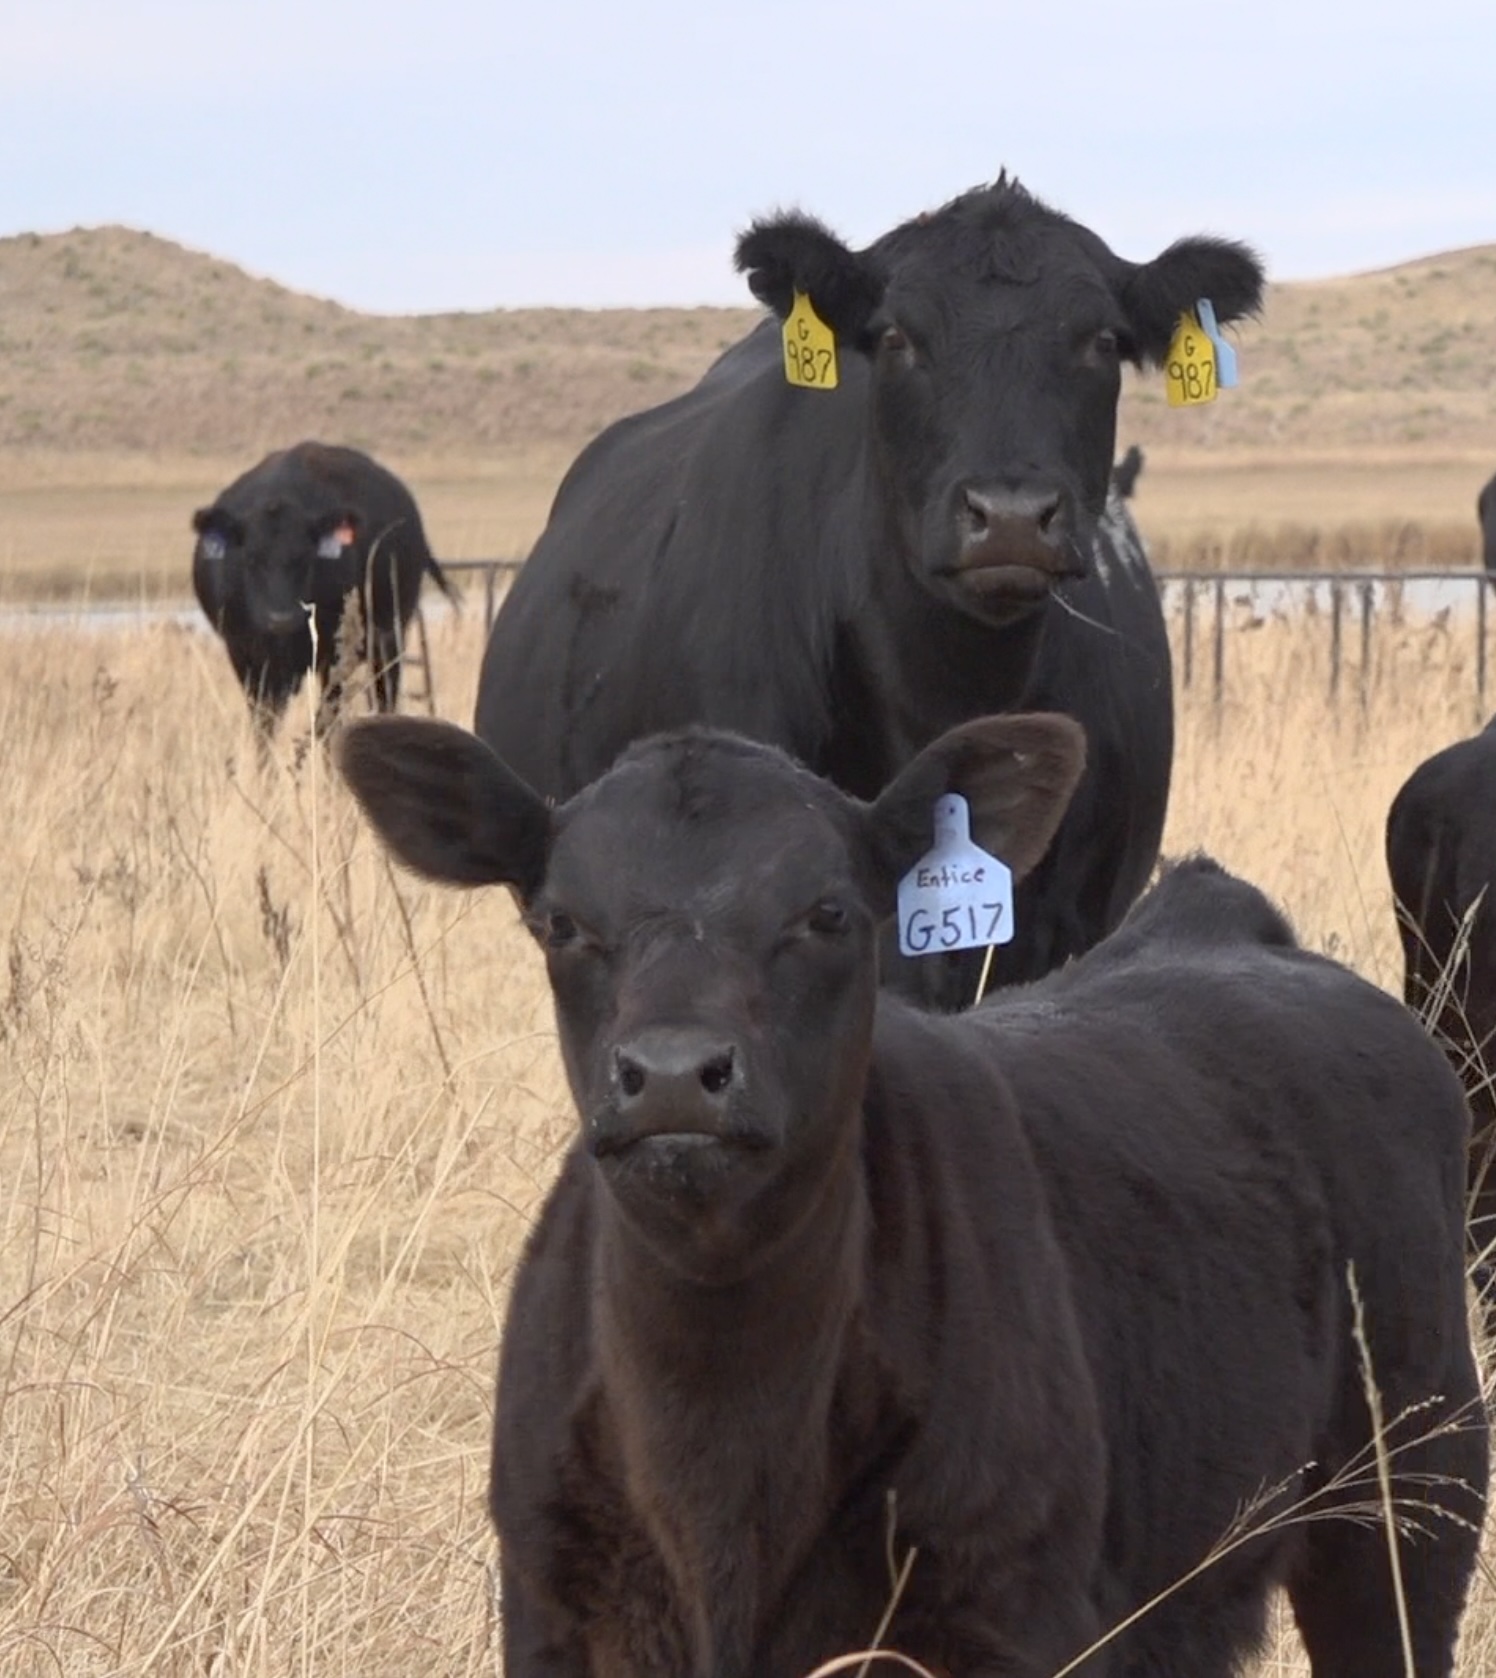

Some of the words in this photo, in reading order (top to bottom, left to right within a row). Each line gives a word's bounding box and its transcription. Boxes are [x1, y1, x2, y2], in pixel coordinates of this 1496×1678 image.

[797, 317, 809, 341] G
[787, 339, 832, 384] 987
[1184, 335, 1196, 357] G
[1168, 360, 1213, 402] 987
[917, 864, 986, 888] Entice
[907, 902, 1004, 951] G517
